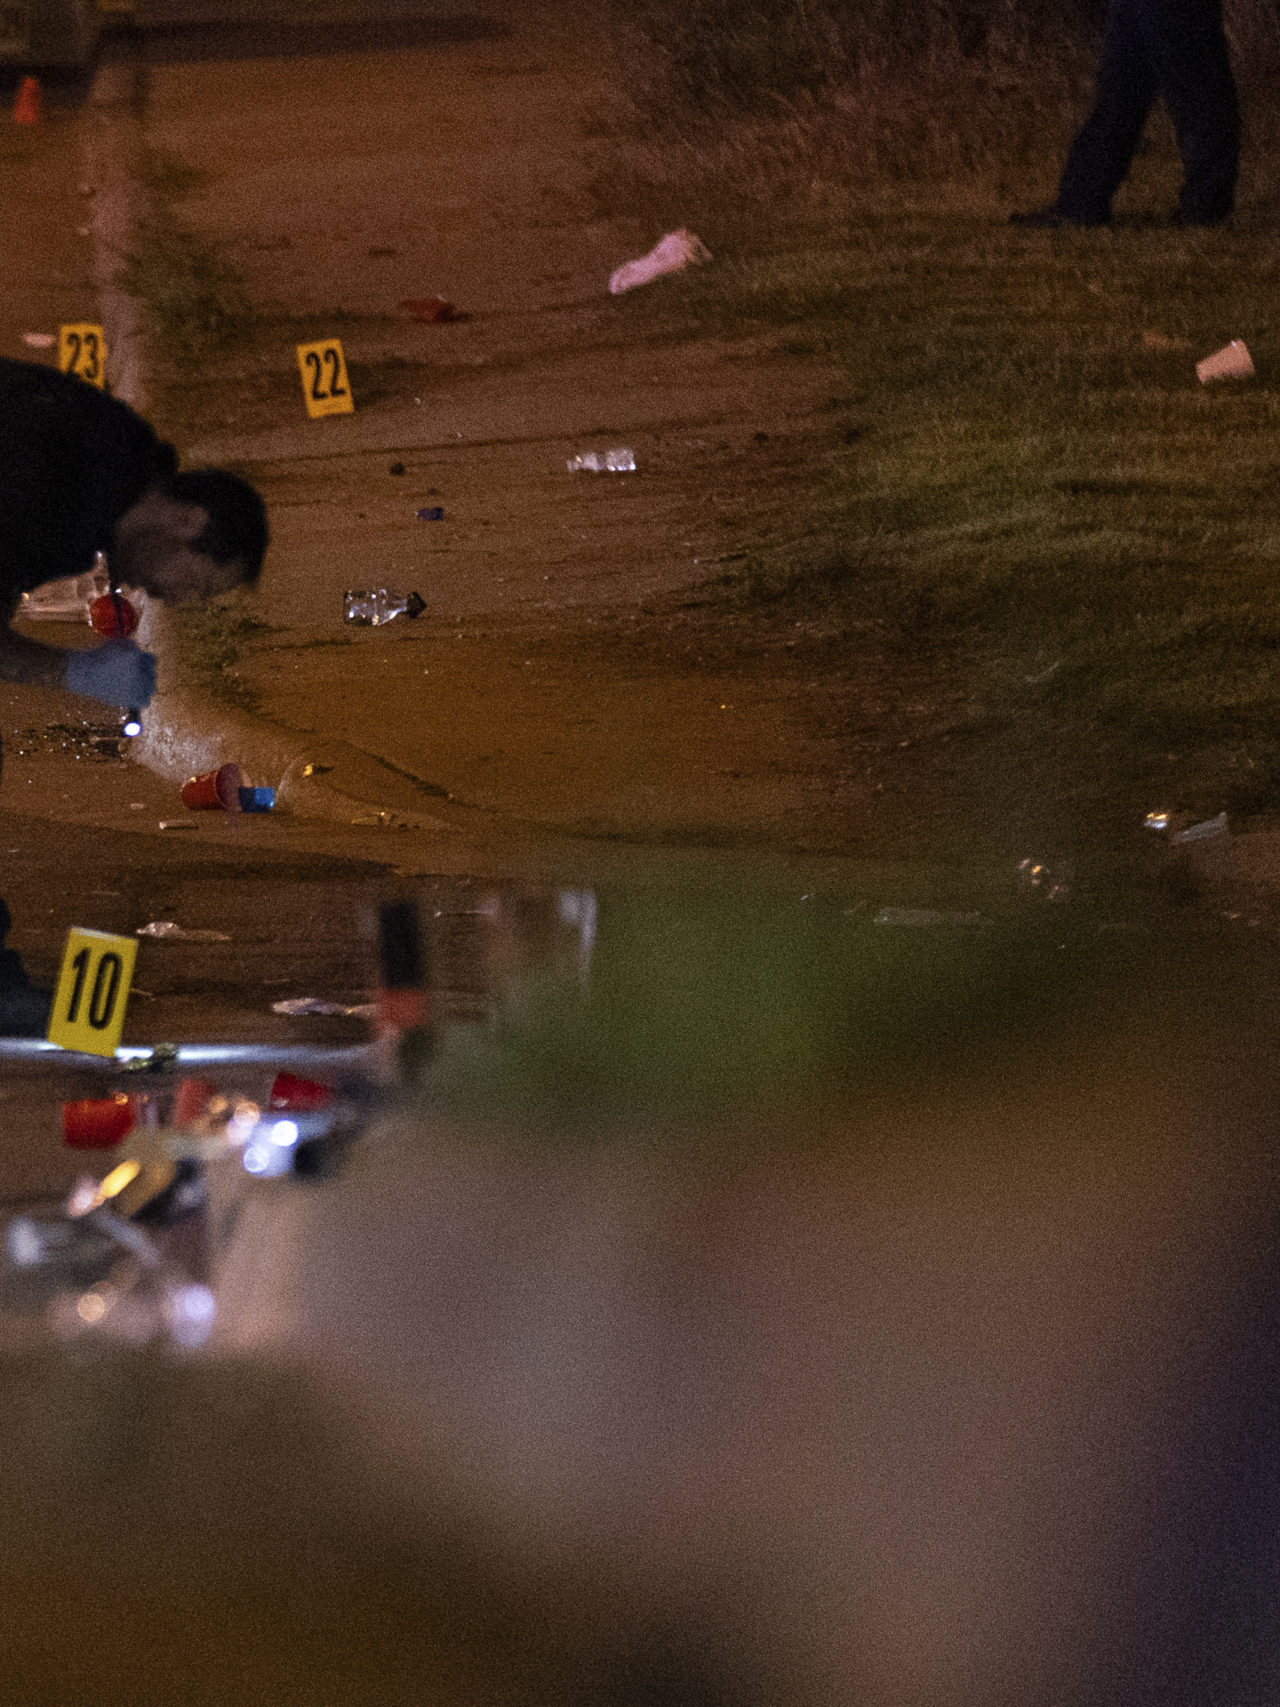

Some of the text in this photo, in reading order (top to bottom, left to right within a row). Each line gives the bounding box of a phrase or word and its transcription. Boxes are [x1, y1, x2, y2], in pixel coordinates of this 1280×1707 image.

[66, 332, 99, 379] 23
[305, 348, 347, 400] 22
[66, 947, 124, 1031] 10
